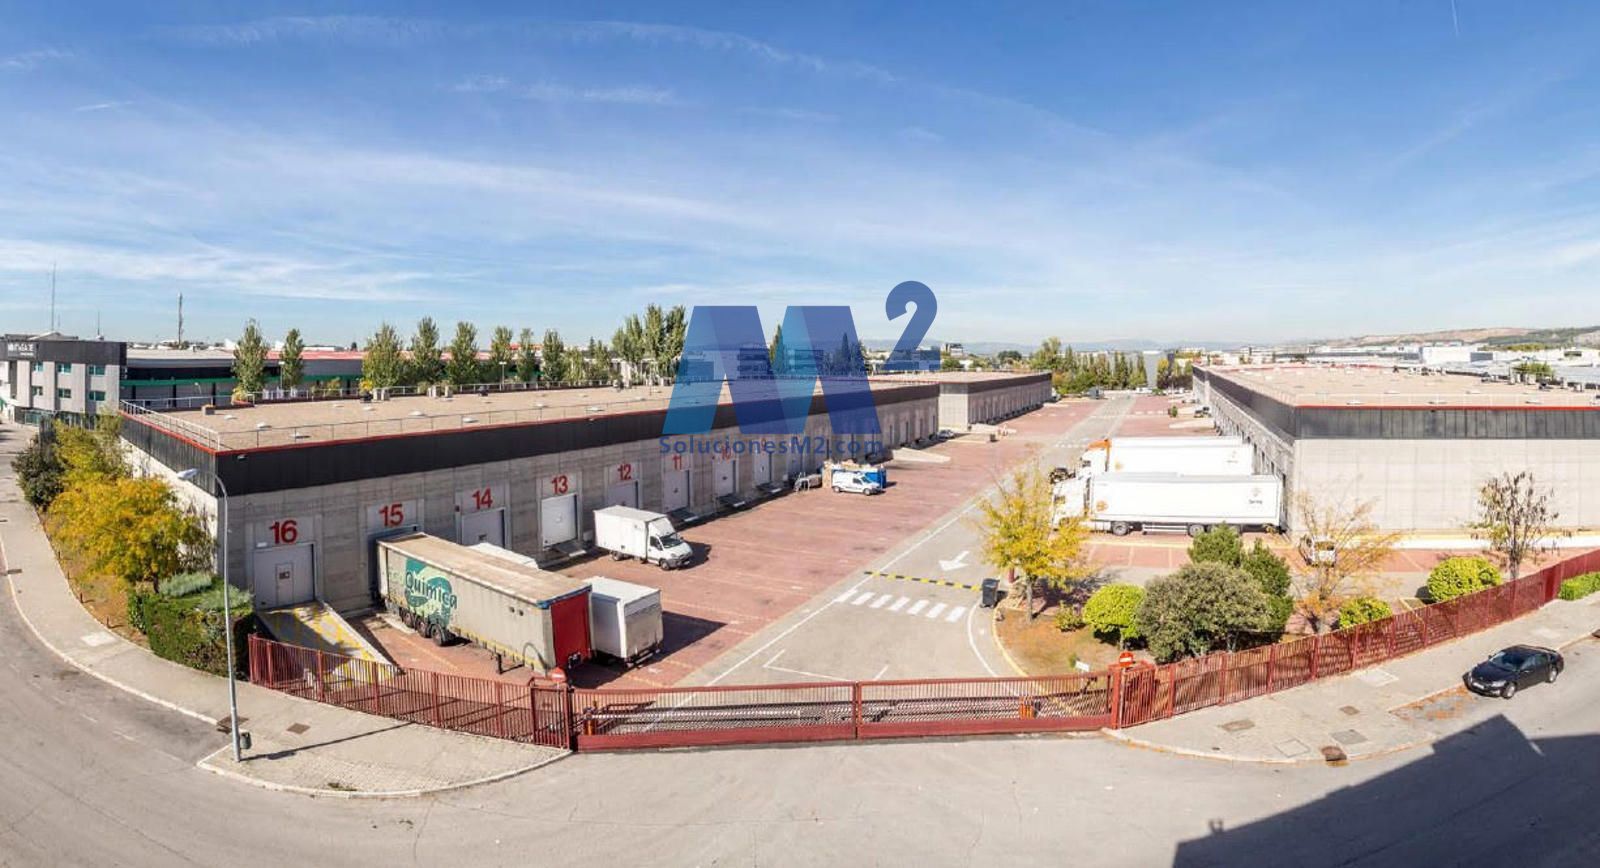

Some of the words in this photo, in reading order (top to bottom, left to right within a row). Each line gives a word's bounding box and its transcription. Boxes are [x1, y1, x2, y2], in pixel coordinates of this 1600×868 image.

[617, 464, 632, 481] 12
[672, 455, 682, 471] 11
[551, 475, 568, 494] 13
[472, 488, 493, 510] 14
[379, 504, 404, 527] 15
[269, 520, 298, 544] 16
